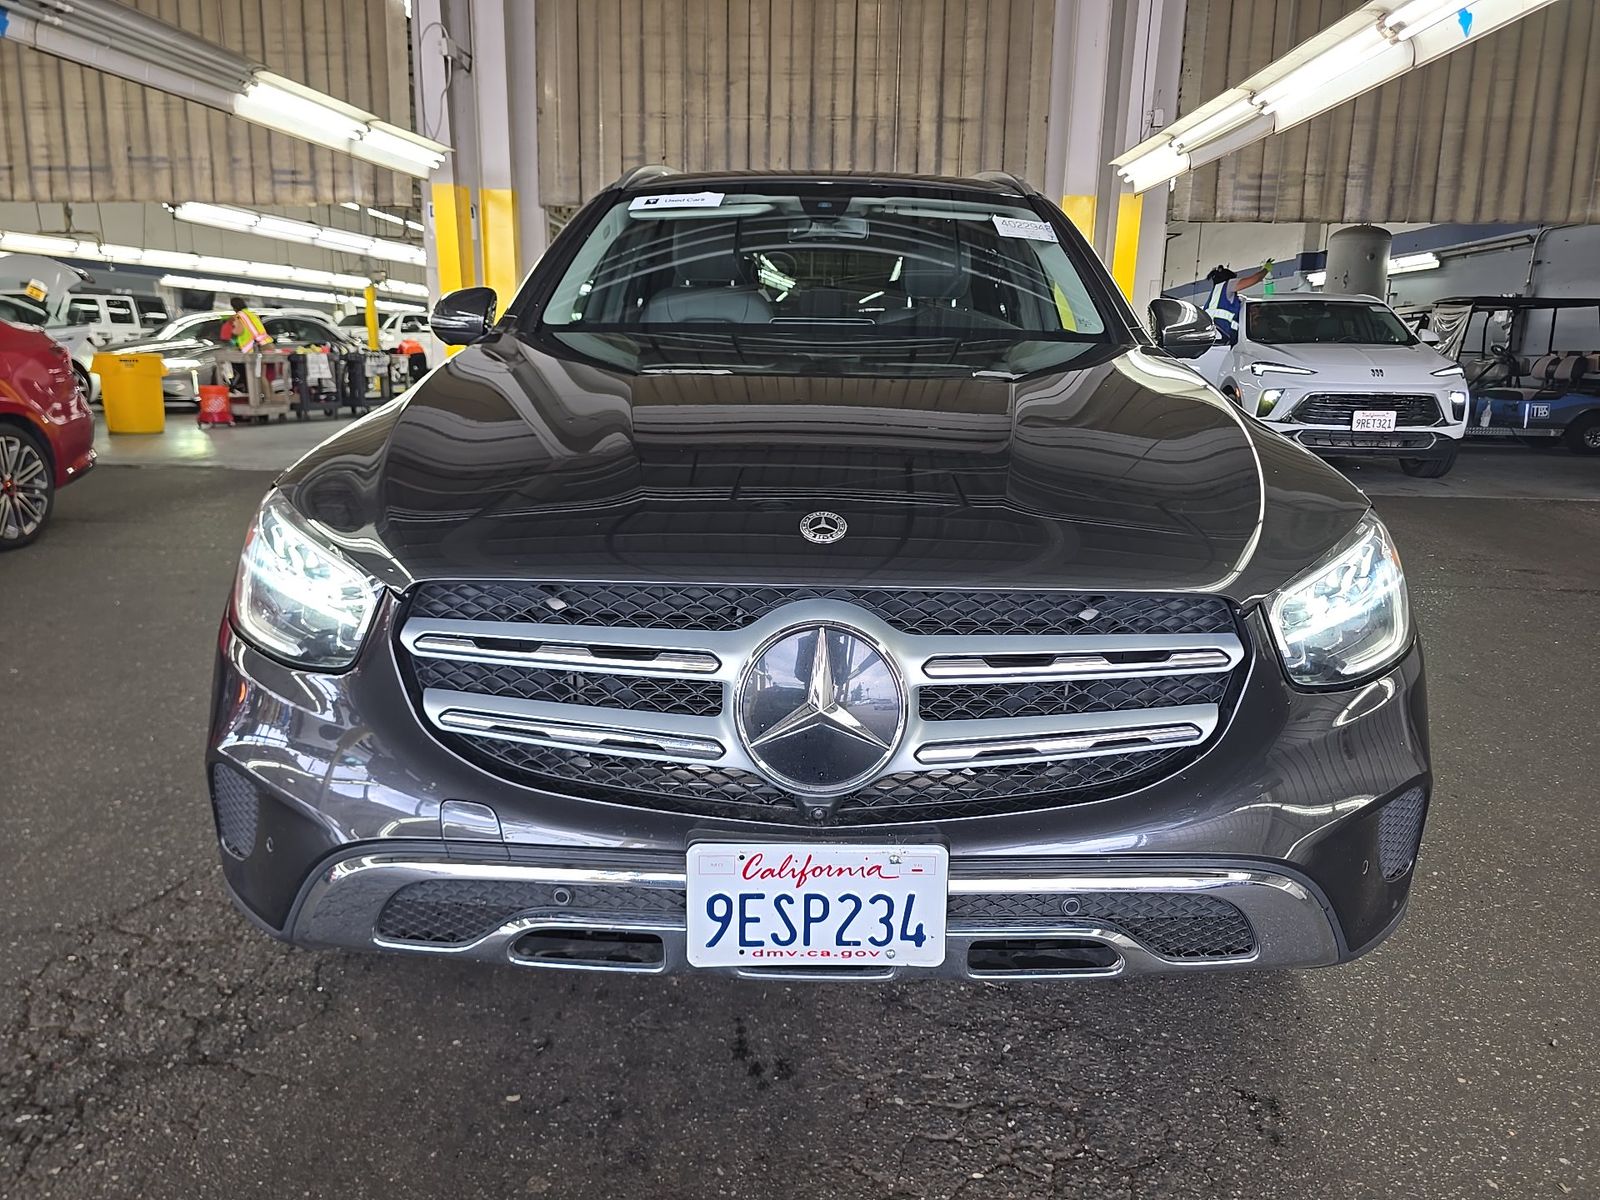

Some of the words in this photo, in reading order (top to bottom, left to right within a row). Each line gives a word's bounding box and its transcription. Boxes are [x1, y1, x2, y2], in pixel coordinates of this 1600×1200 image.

[1355, 418, 1392, 430] 9RET321
[742, 853, 899, 888] California
[705, 893, 927, 948] 9ESP234
[752, 948, 881, 959] dmv.ca.gov
